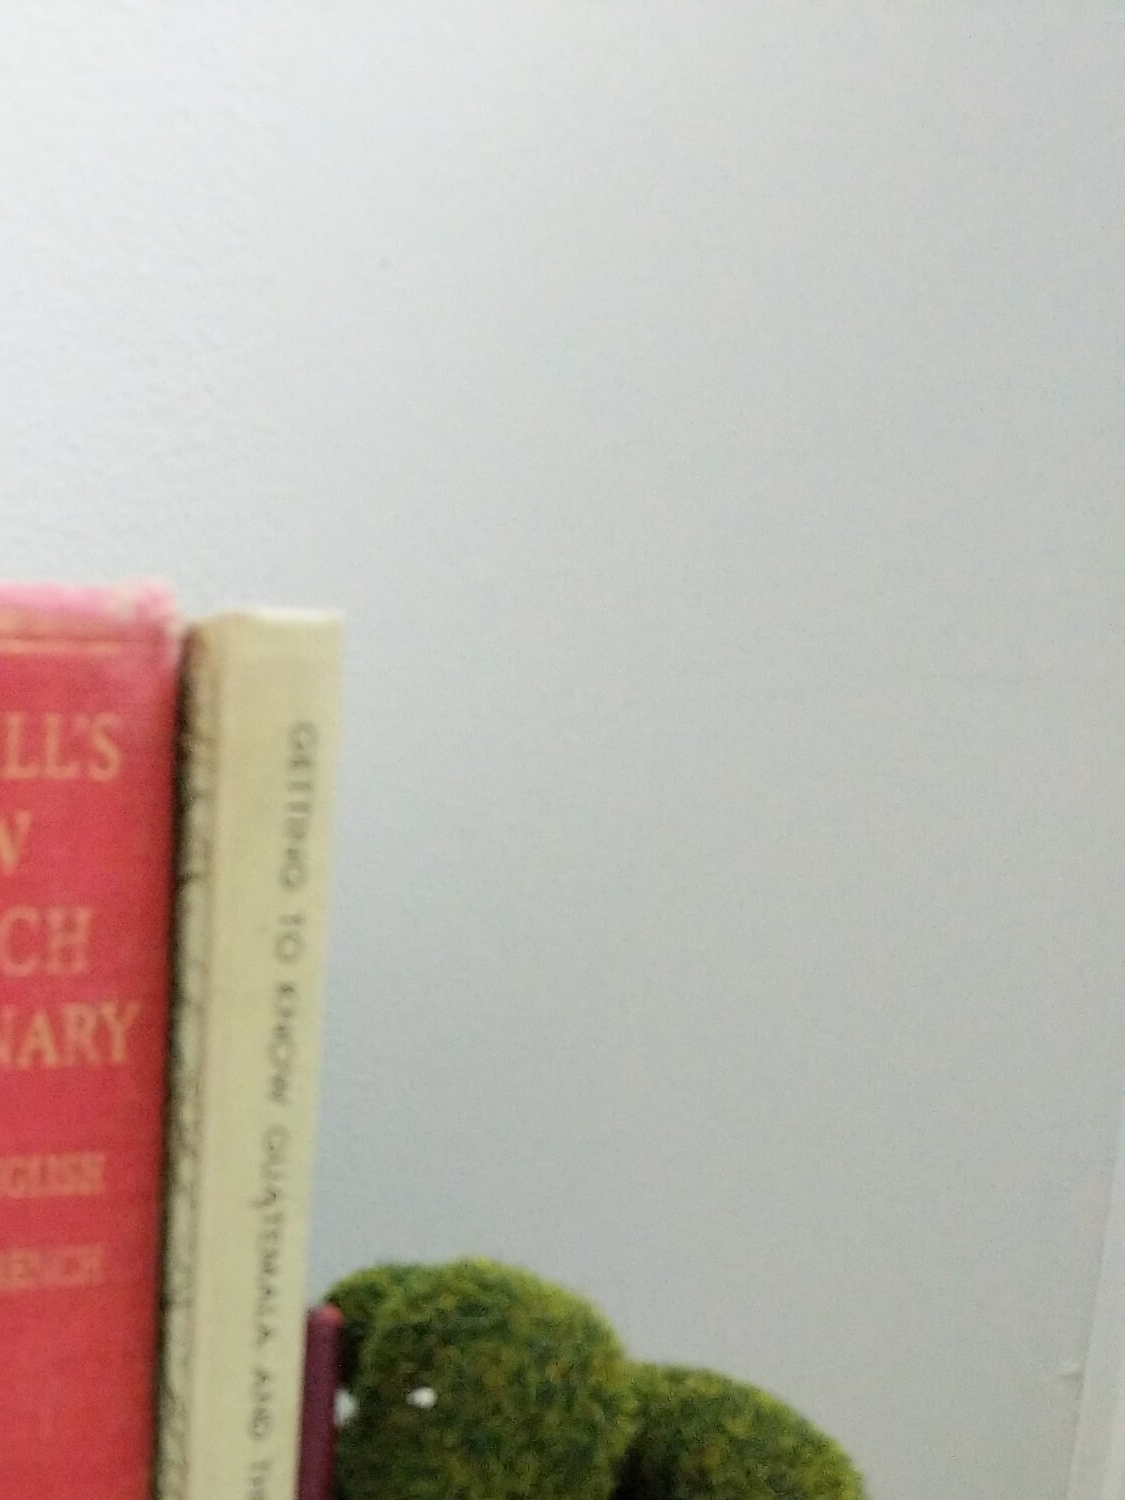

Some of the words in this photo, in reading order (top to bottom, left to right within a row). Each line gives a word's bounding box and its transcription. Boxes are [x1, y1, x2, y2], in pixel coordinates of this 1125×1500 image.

[278, 721, 320, 890] GETTING
[276, 912, 306, 965] TO
[268, 979, 299, 1104] KNOW
[247, 1366, 275, 1441] AND
